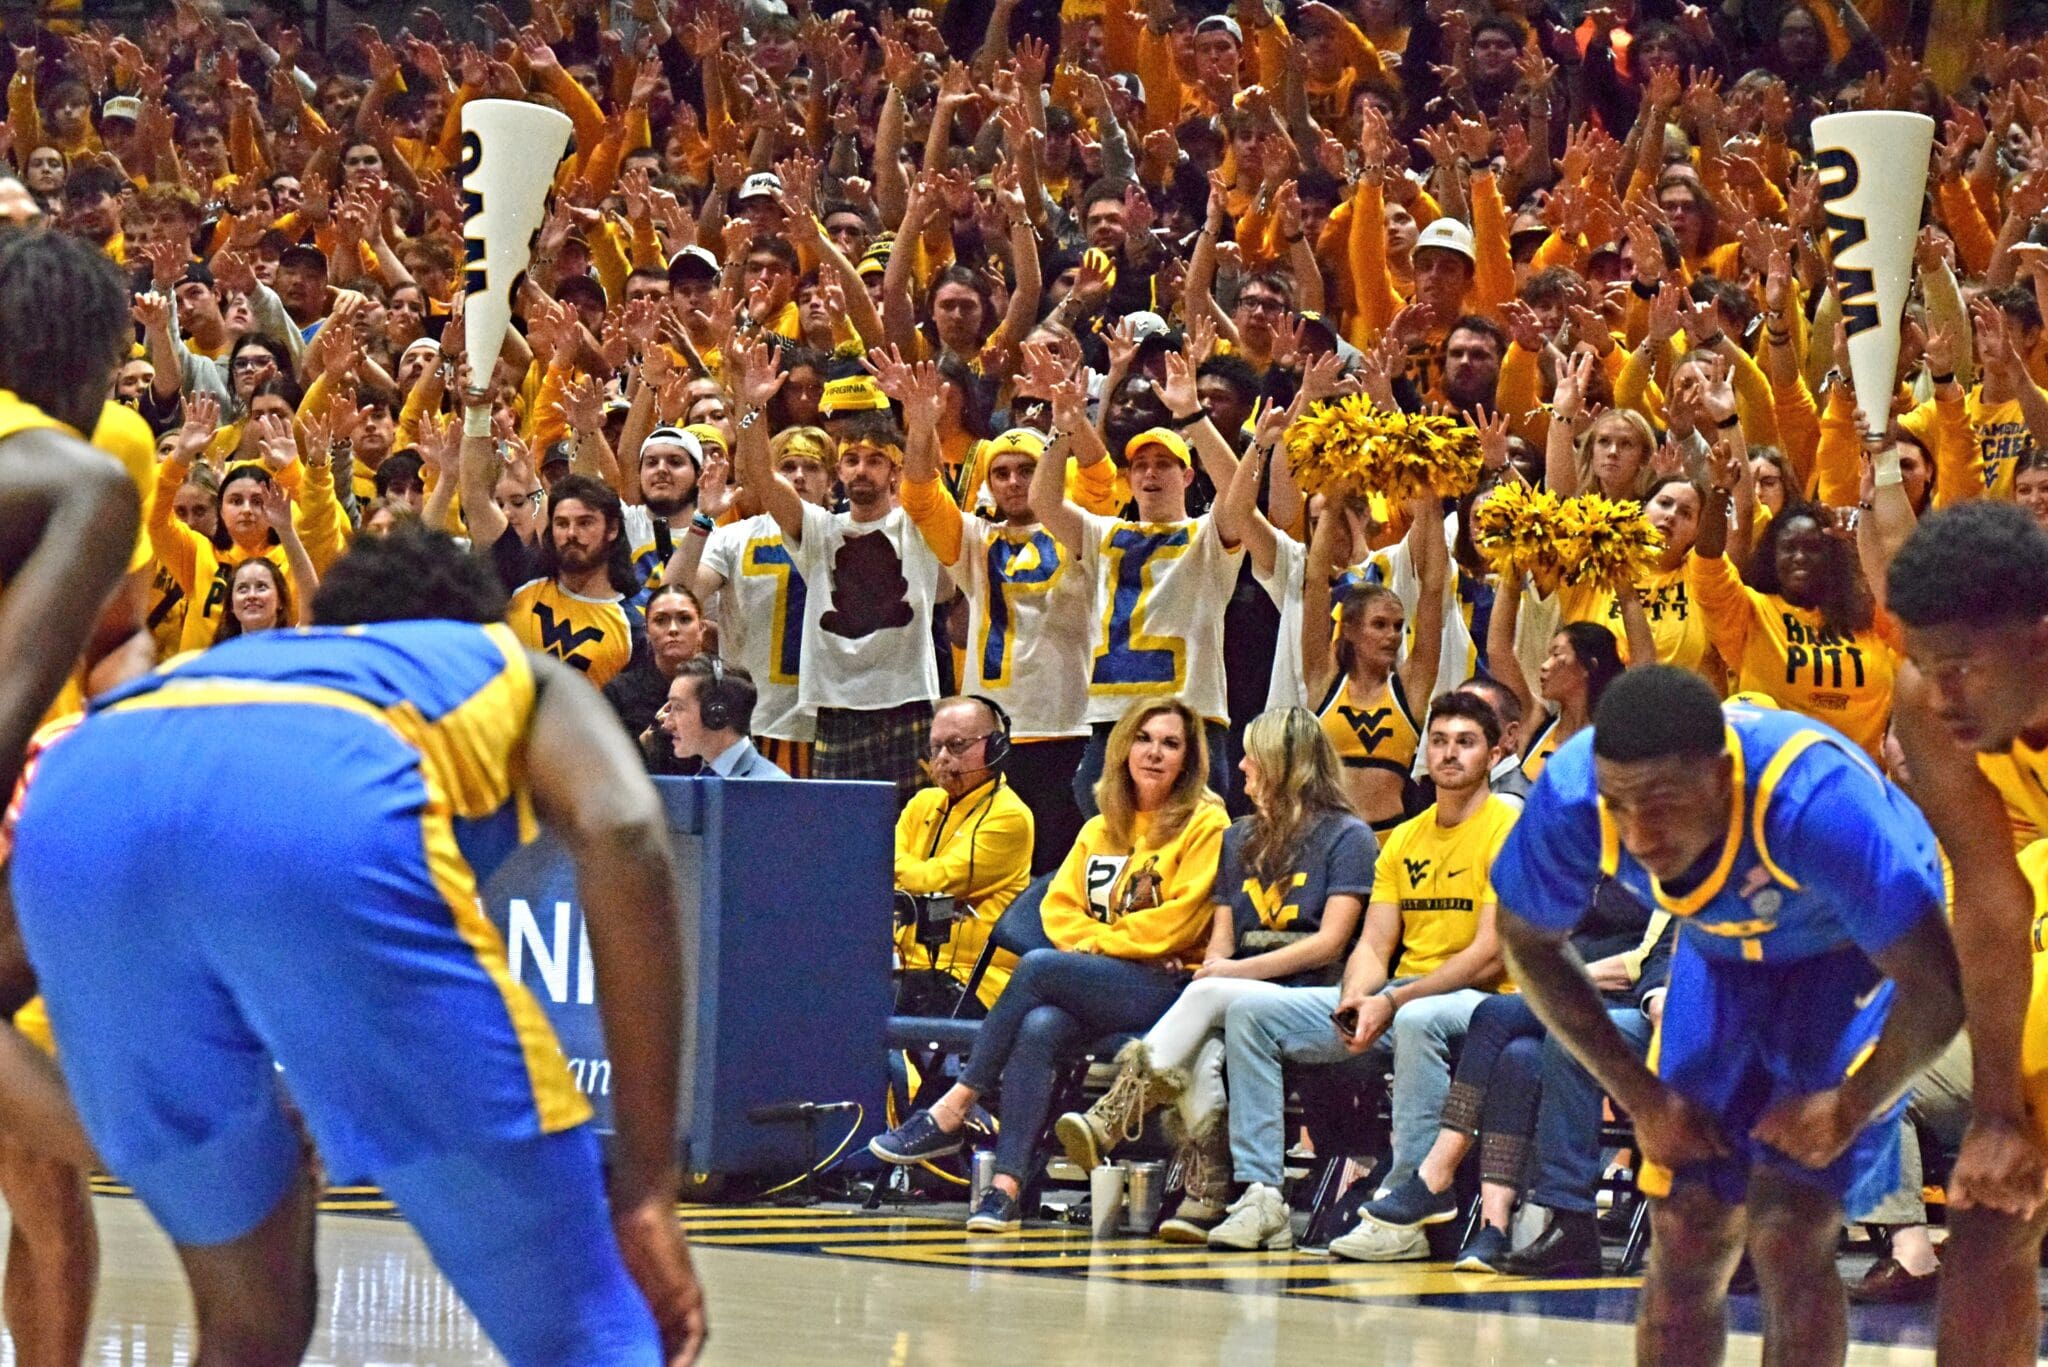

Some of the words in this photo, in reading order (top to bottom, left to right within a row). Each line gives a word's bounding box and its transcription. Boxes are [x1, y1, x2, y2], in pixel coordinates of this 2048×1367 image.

[1816, 148, 1882, 338] WVU
[978, 523, 1067, 691] P
[1786, 645, 1865, 688] PITT
